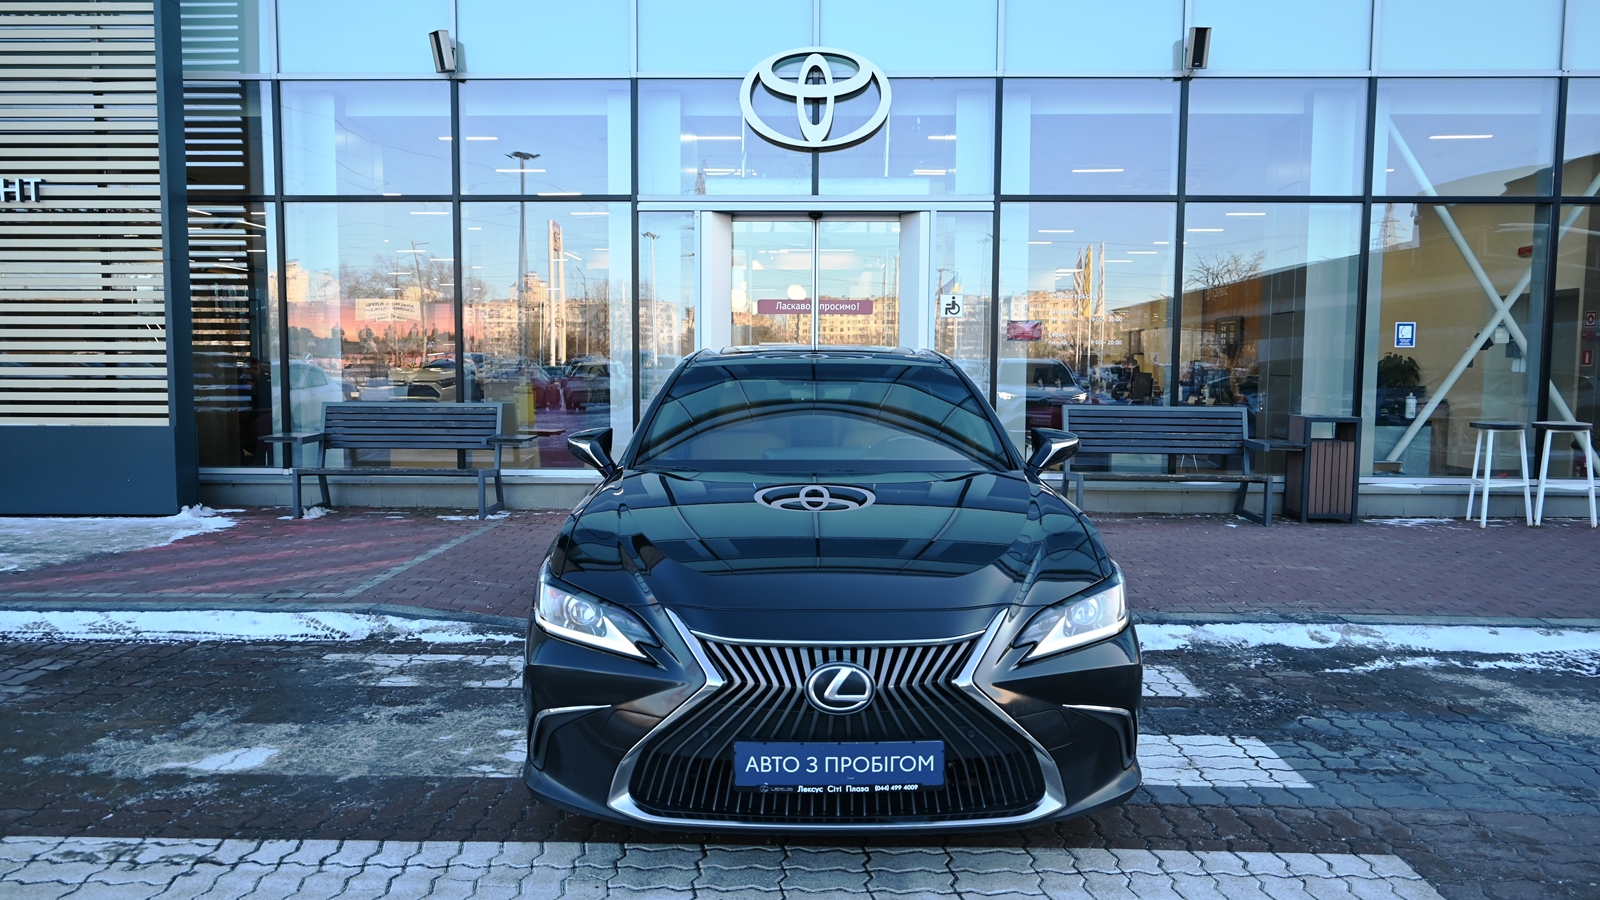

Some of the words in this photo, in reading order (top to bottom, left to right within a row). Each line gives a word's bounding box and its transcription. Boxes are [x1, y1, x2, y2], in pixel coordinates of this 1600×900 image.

[775, 301, 811, 311] Ласкаво
[819, 302, 860, 312] просимо!
[745, 756, 800, 773] АВТО
[806, 756, 818, 773] З
[825, 755, 935, 773] ПРОБІГОМ
[797, 785, 824, 793] Лексус
[827, 785, 842, 793] Сіті
[846, 785, 870, 793] Плаза
[874, 784, 890, 792] (044)
